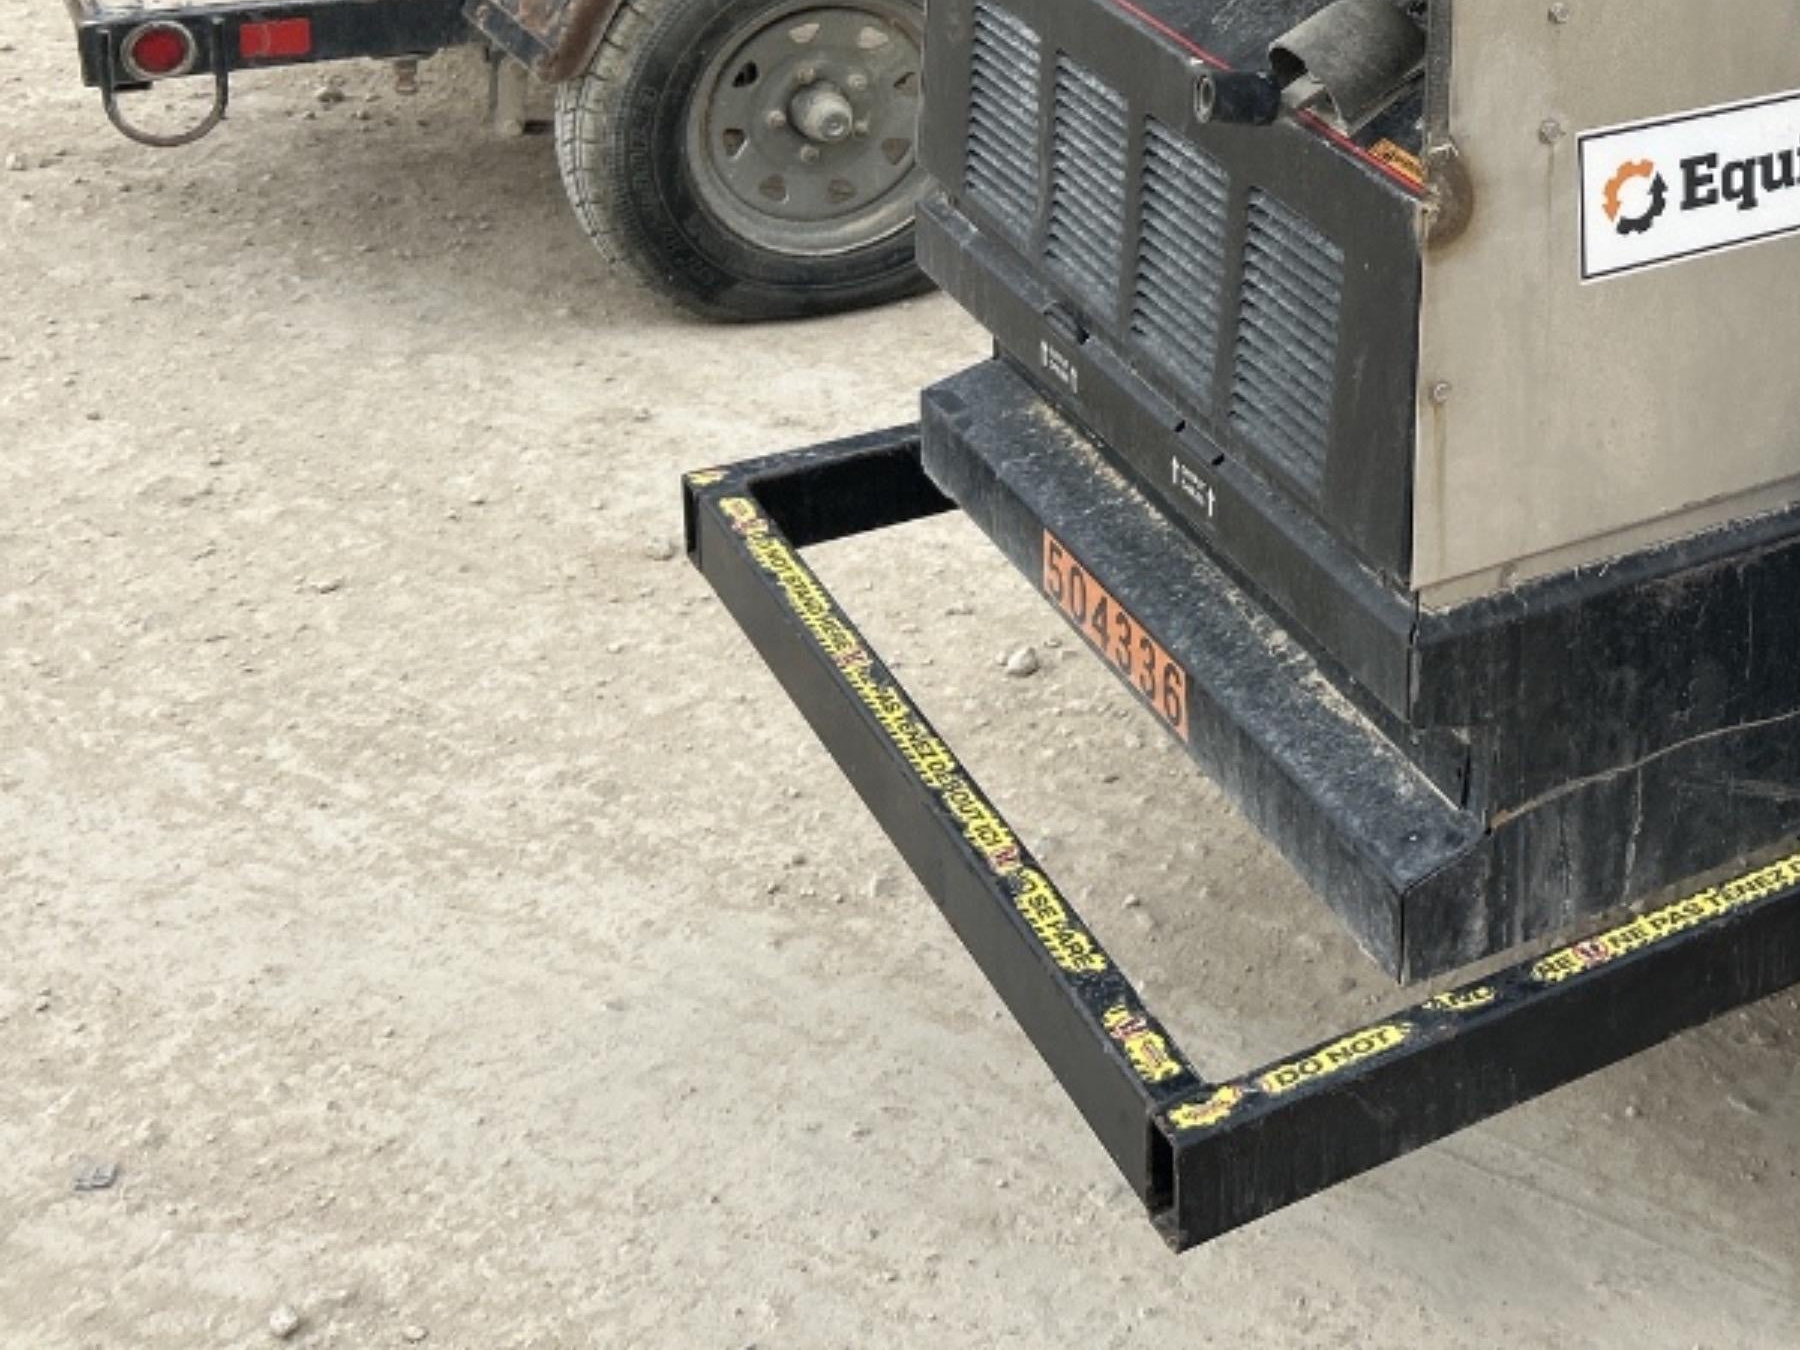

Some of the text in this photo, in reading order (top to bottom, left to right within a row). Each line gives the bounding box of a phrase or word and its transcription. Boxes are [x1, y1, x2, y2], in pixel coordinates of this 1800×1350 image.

[1047, 541, 1181, 727] 504336
[1273, 1028, 1392, 1087] DO NOT
